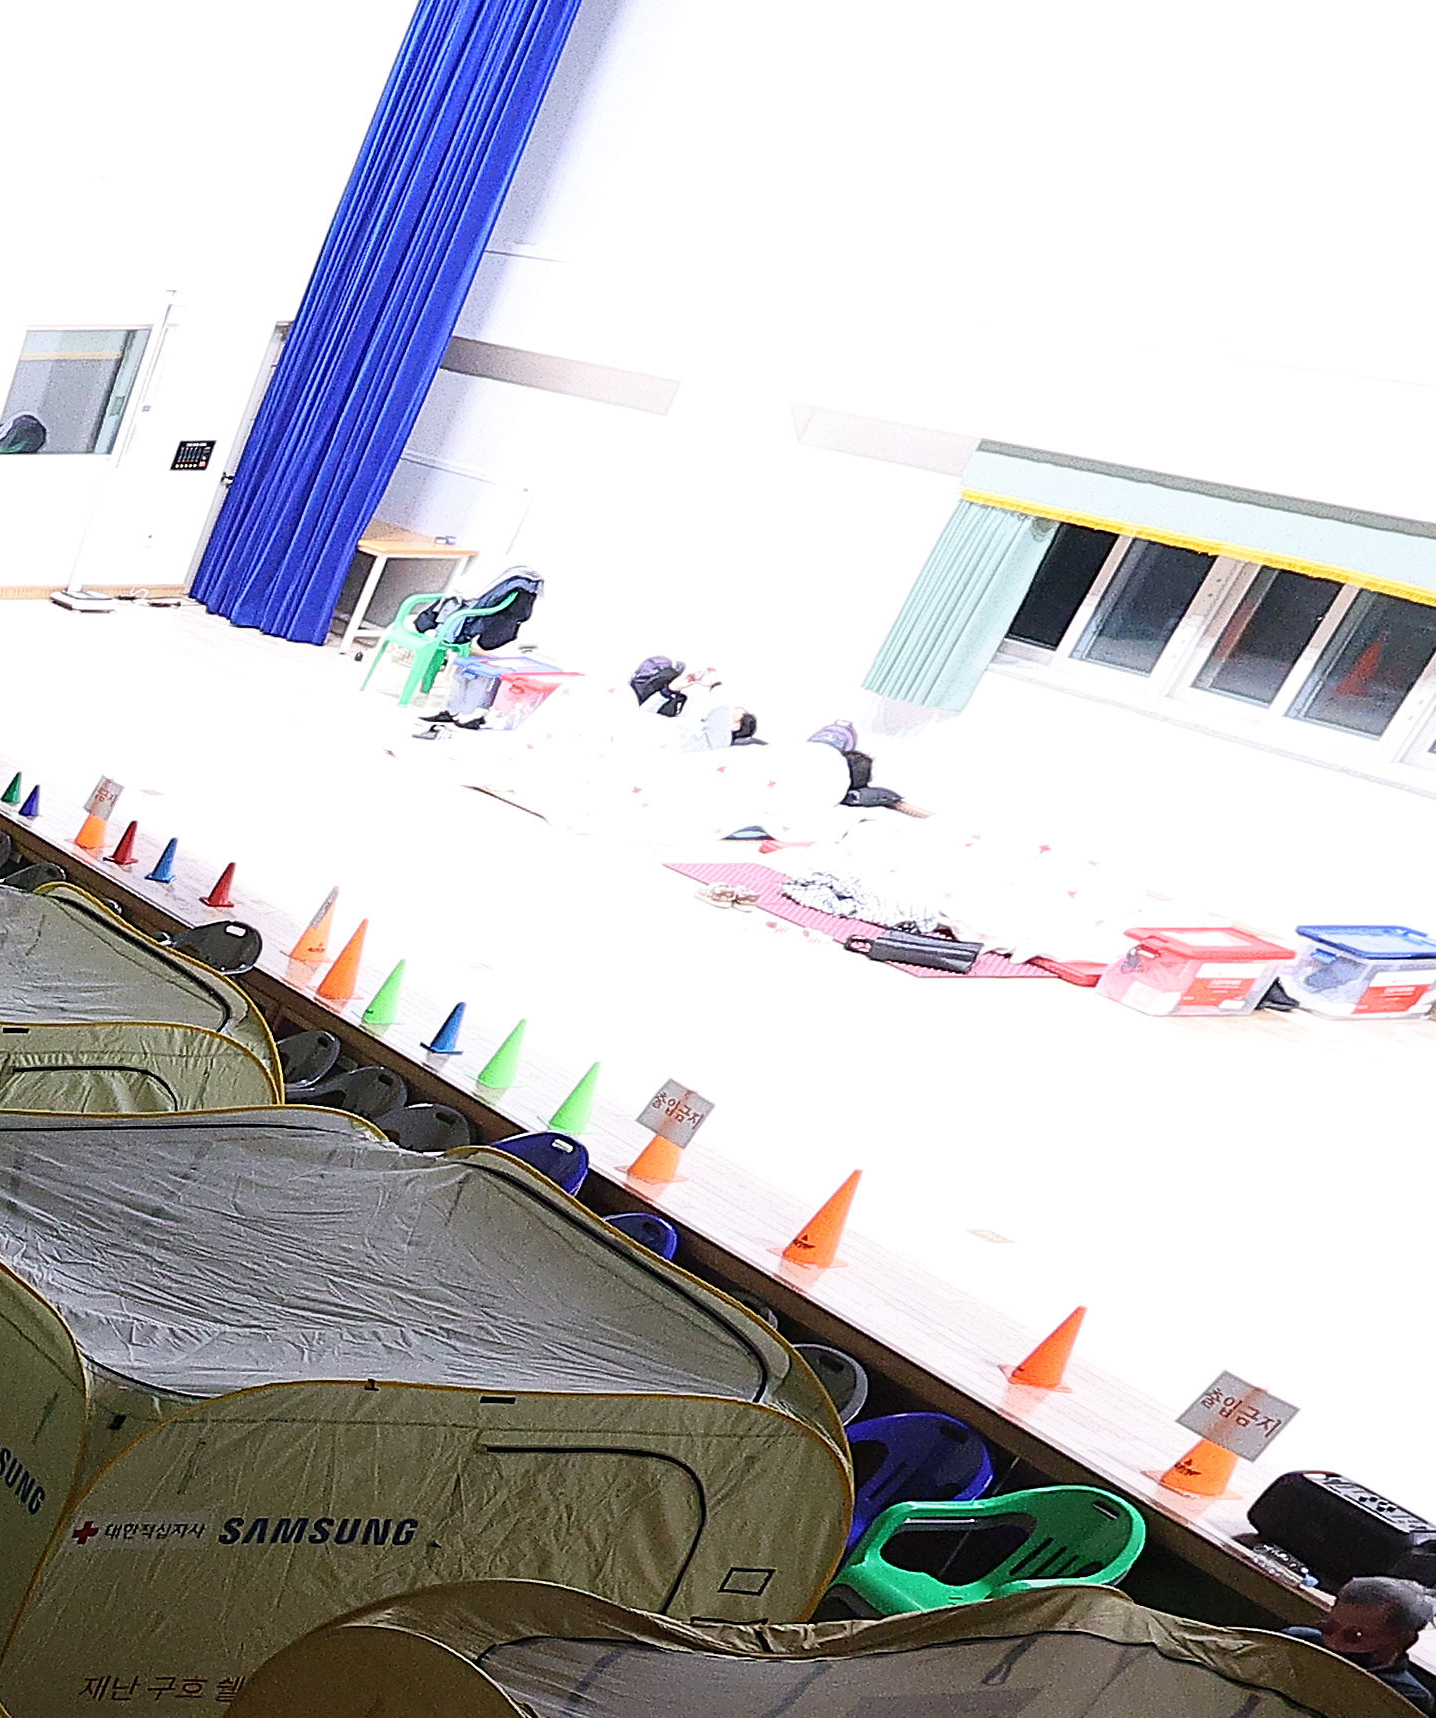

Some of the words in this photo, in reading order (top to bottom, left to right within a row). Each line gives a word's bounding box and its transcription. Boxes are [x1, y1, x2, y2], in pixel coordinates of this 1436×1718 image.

[651, 1090, 704, 1131] 출입금지
[1199, 1385, 1284, 1439] 출입금지
[104, 1523, 206, 1539] 대한적십자사
[218, 1516, 420, 1547] SAMSUNG
[79, 1674, 139, 1702] 재난
[147, 1675, 209, 1702] 구호
[216, 1675, 246, 1702] 쉘
